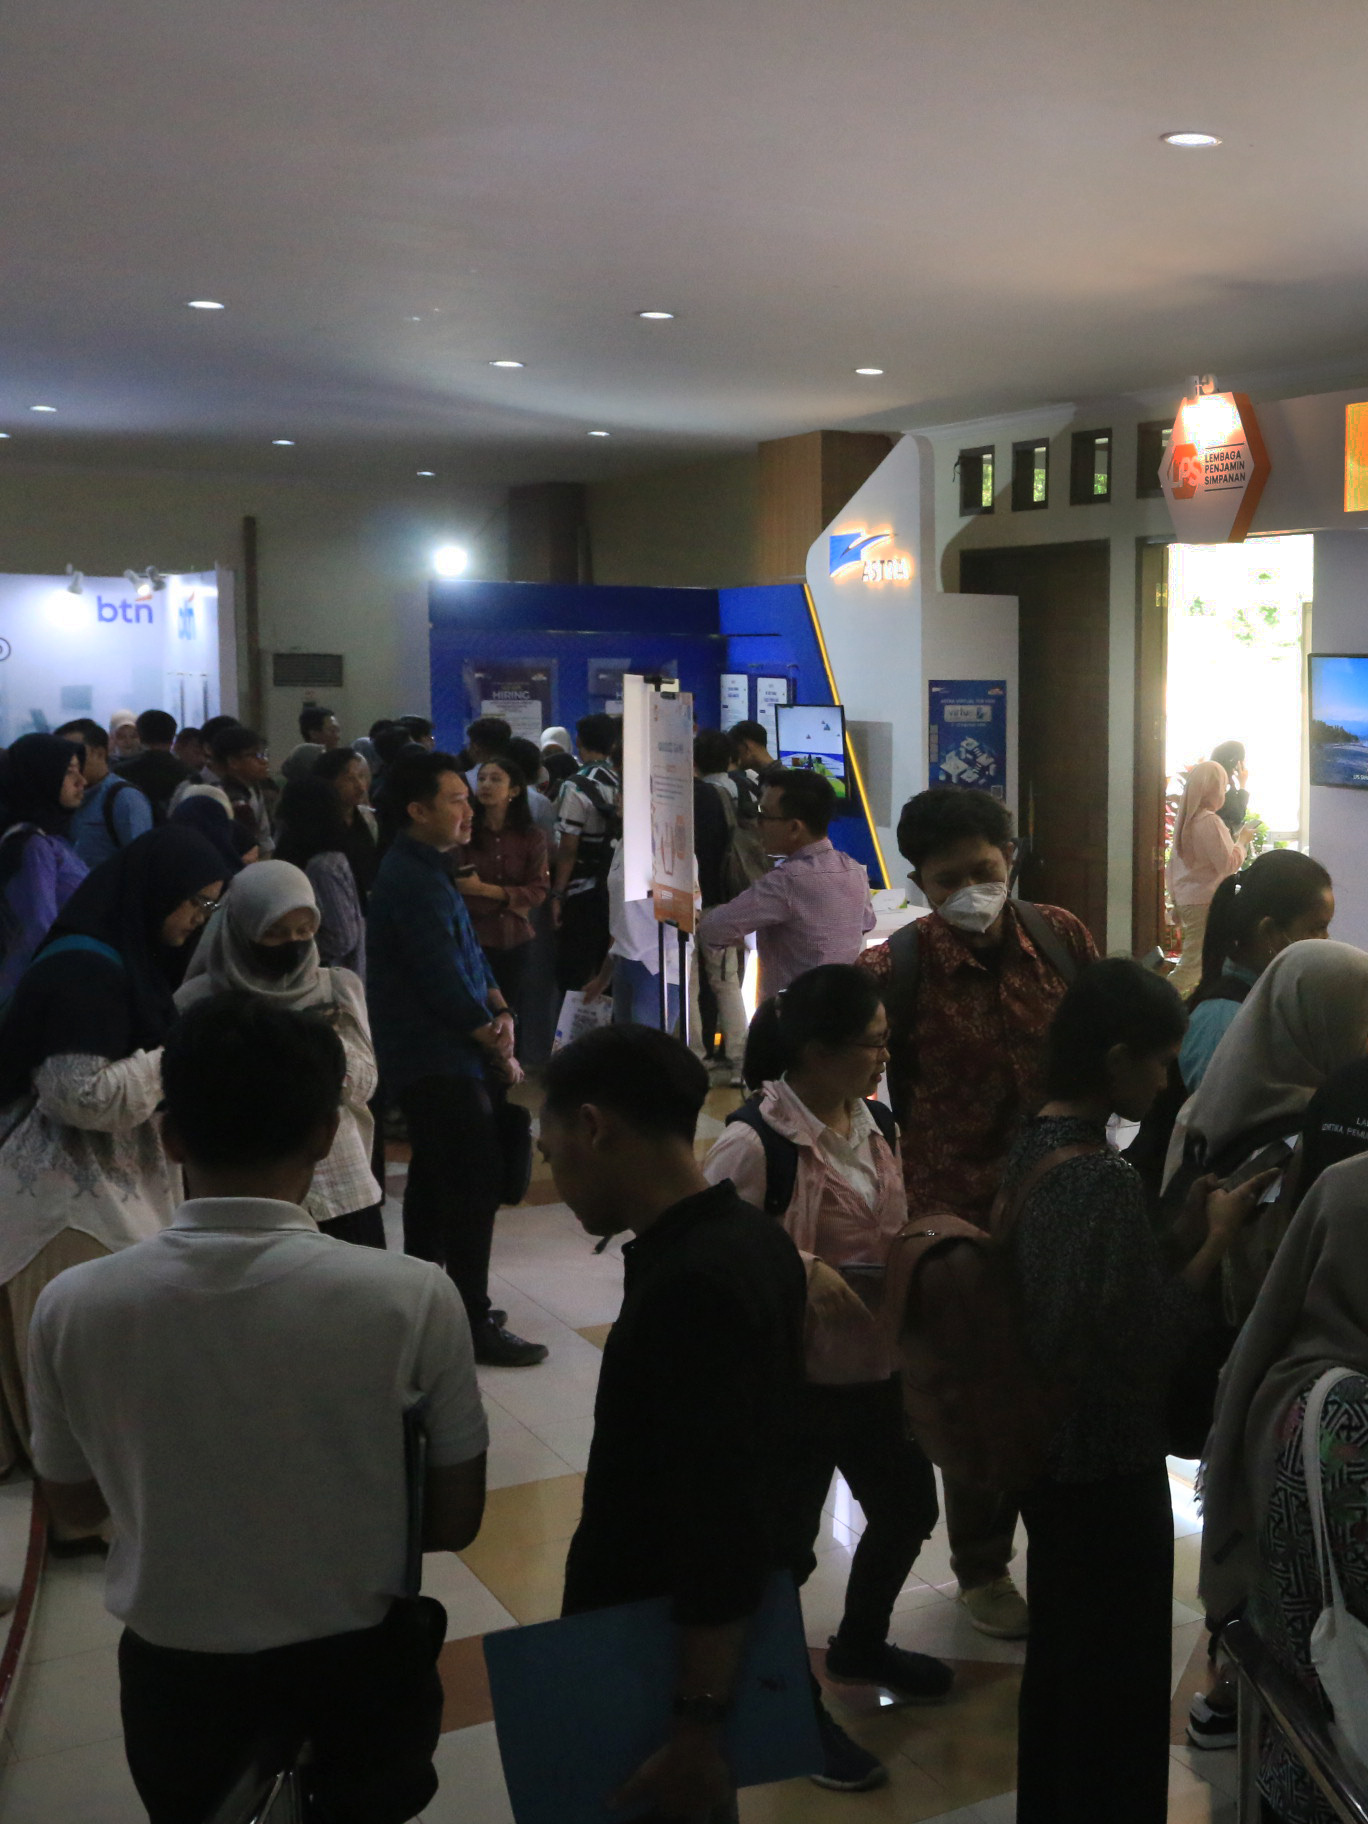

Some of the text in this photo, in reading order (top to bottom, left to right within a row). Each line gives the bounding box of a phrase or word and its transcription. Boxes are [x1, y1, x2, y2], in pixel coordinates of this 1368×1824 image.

[1204, 450, 1242, 463] LEMBAGA
[1166, 456, 1203, 488] LPS
[1204, 461, 1245, 474] PENJAMIN
[1204, 472, 1246, 485] SIMPANAN
[97, 594, 154, 624] btn
[492, 690, 530, 700] HIRING
